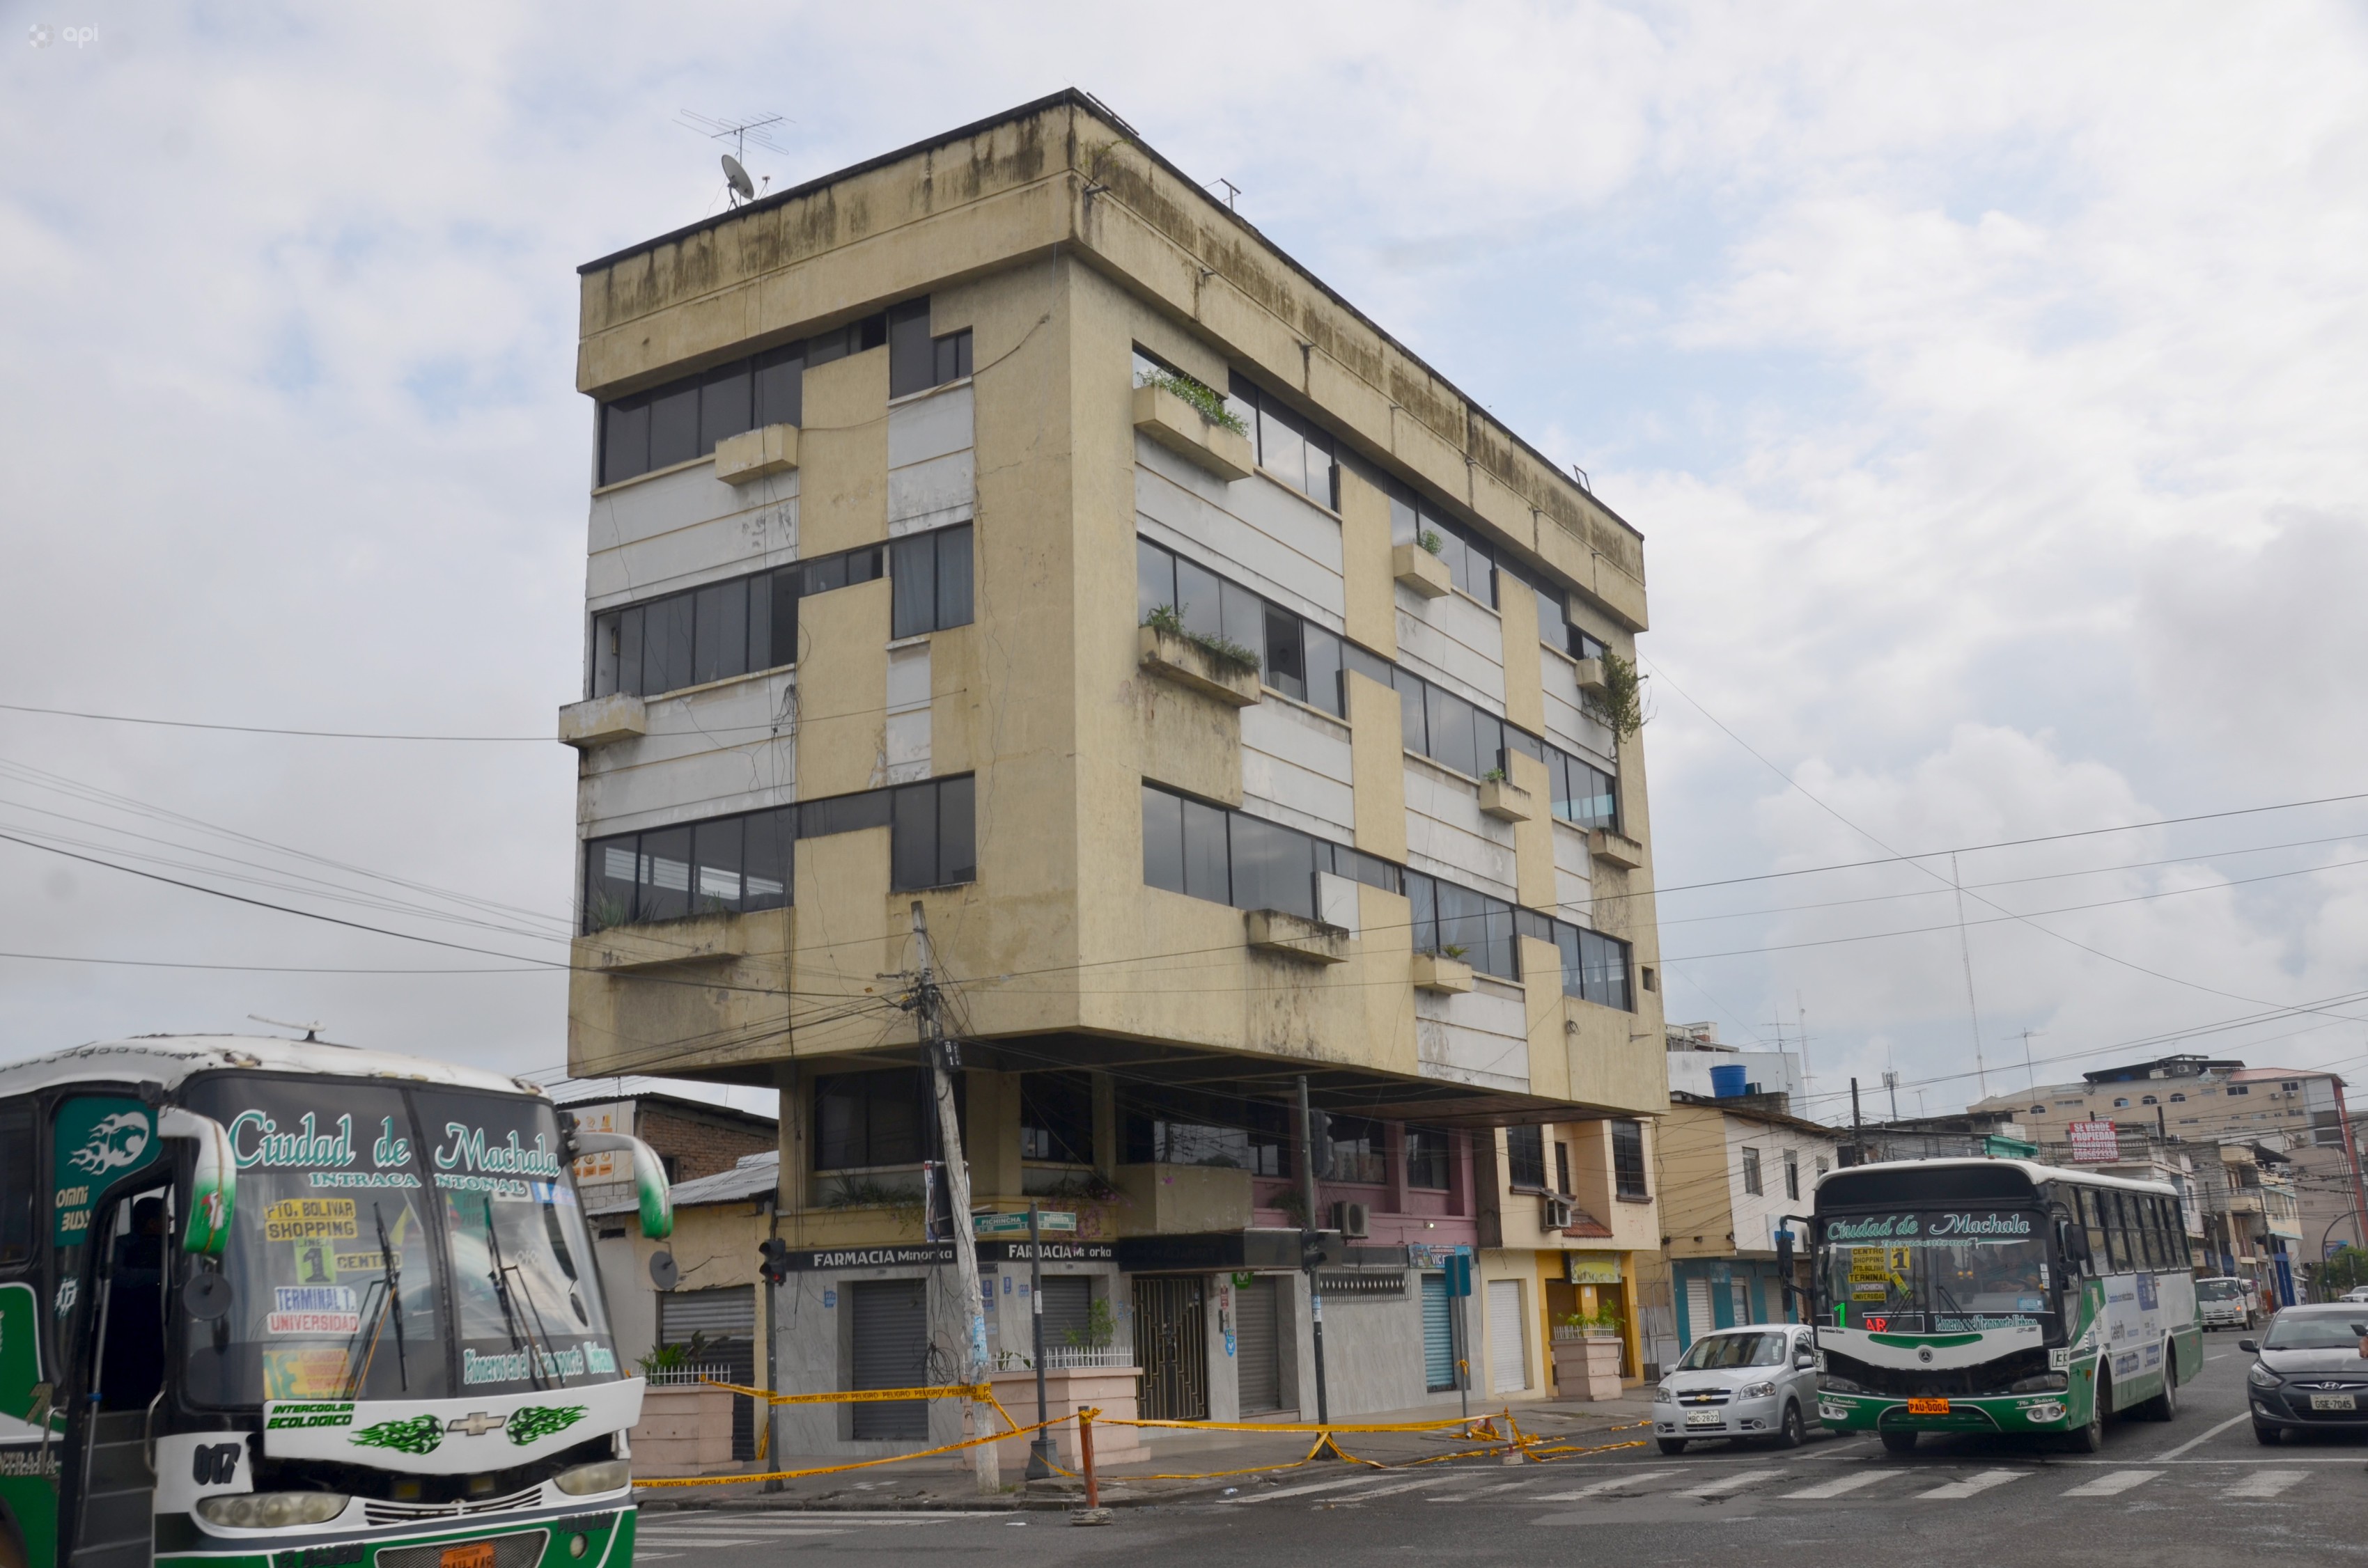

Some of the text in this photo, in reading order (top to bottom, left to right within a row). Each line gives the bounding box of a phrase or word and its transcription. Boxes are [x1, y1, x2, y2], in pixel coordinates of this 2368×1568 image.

[2074, 1122, 2110, 1132] SE VENDE
[228, 1109, 561, 1178] Ciudad de Machala
[2071, 1131, 2115, 1141] PROPIEDAD
[267, 1202, 354, 1218] PTO. BOLIVAR
[981, 1216, 1021, 1225] PICHINCHA
[1828, 1214, 2030, 1240] Ciudad de Machala
[269, 1221, 355, 1238] SHOPPING
[303, 1248, 331, 1283] 1
[813, 1250, 895, 1267] FARMACIA
[1893, 1252, 1907, 1269] 1
[1850, 1273, 1889, 1282] TERMINAL
[276, 1289, 341, 1310] TERMINAL
[271, 1315, 359, 1332] UNIVERSIDAD
[463, 1348, 506, 1385] Pioneros
[882, 1390, 910, 1399] PELIGRO
[914, 1388, 943, 1397] PELIGRO
[947, 1386, 977, 1395] PELIGRO
[271, 1404, 355, 1415] INTERCOOLER
[1909, 1403, 1948, 1411] PAU-0004
[2315, 1400, 2352, 1409] GSE-7045
[266, 1414, 353, 1429] ECOLOGICO
[193, 1443, 241, 1486] 017
